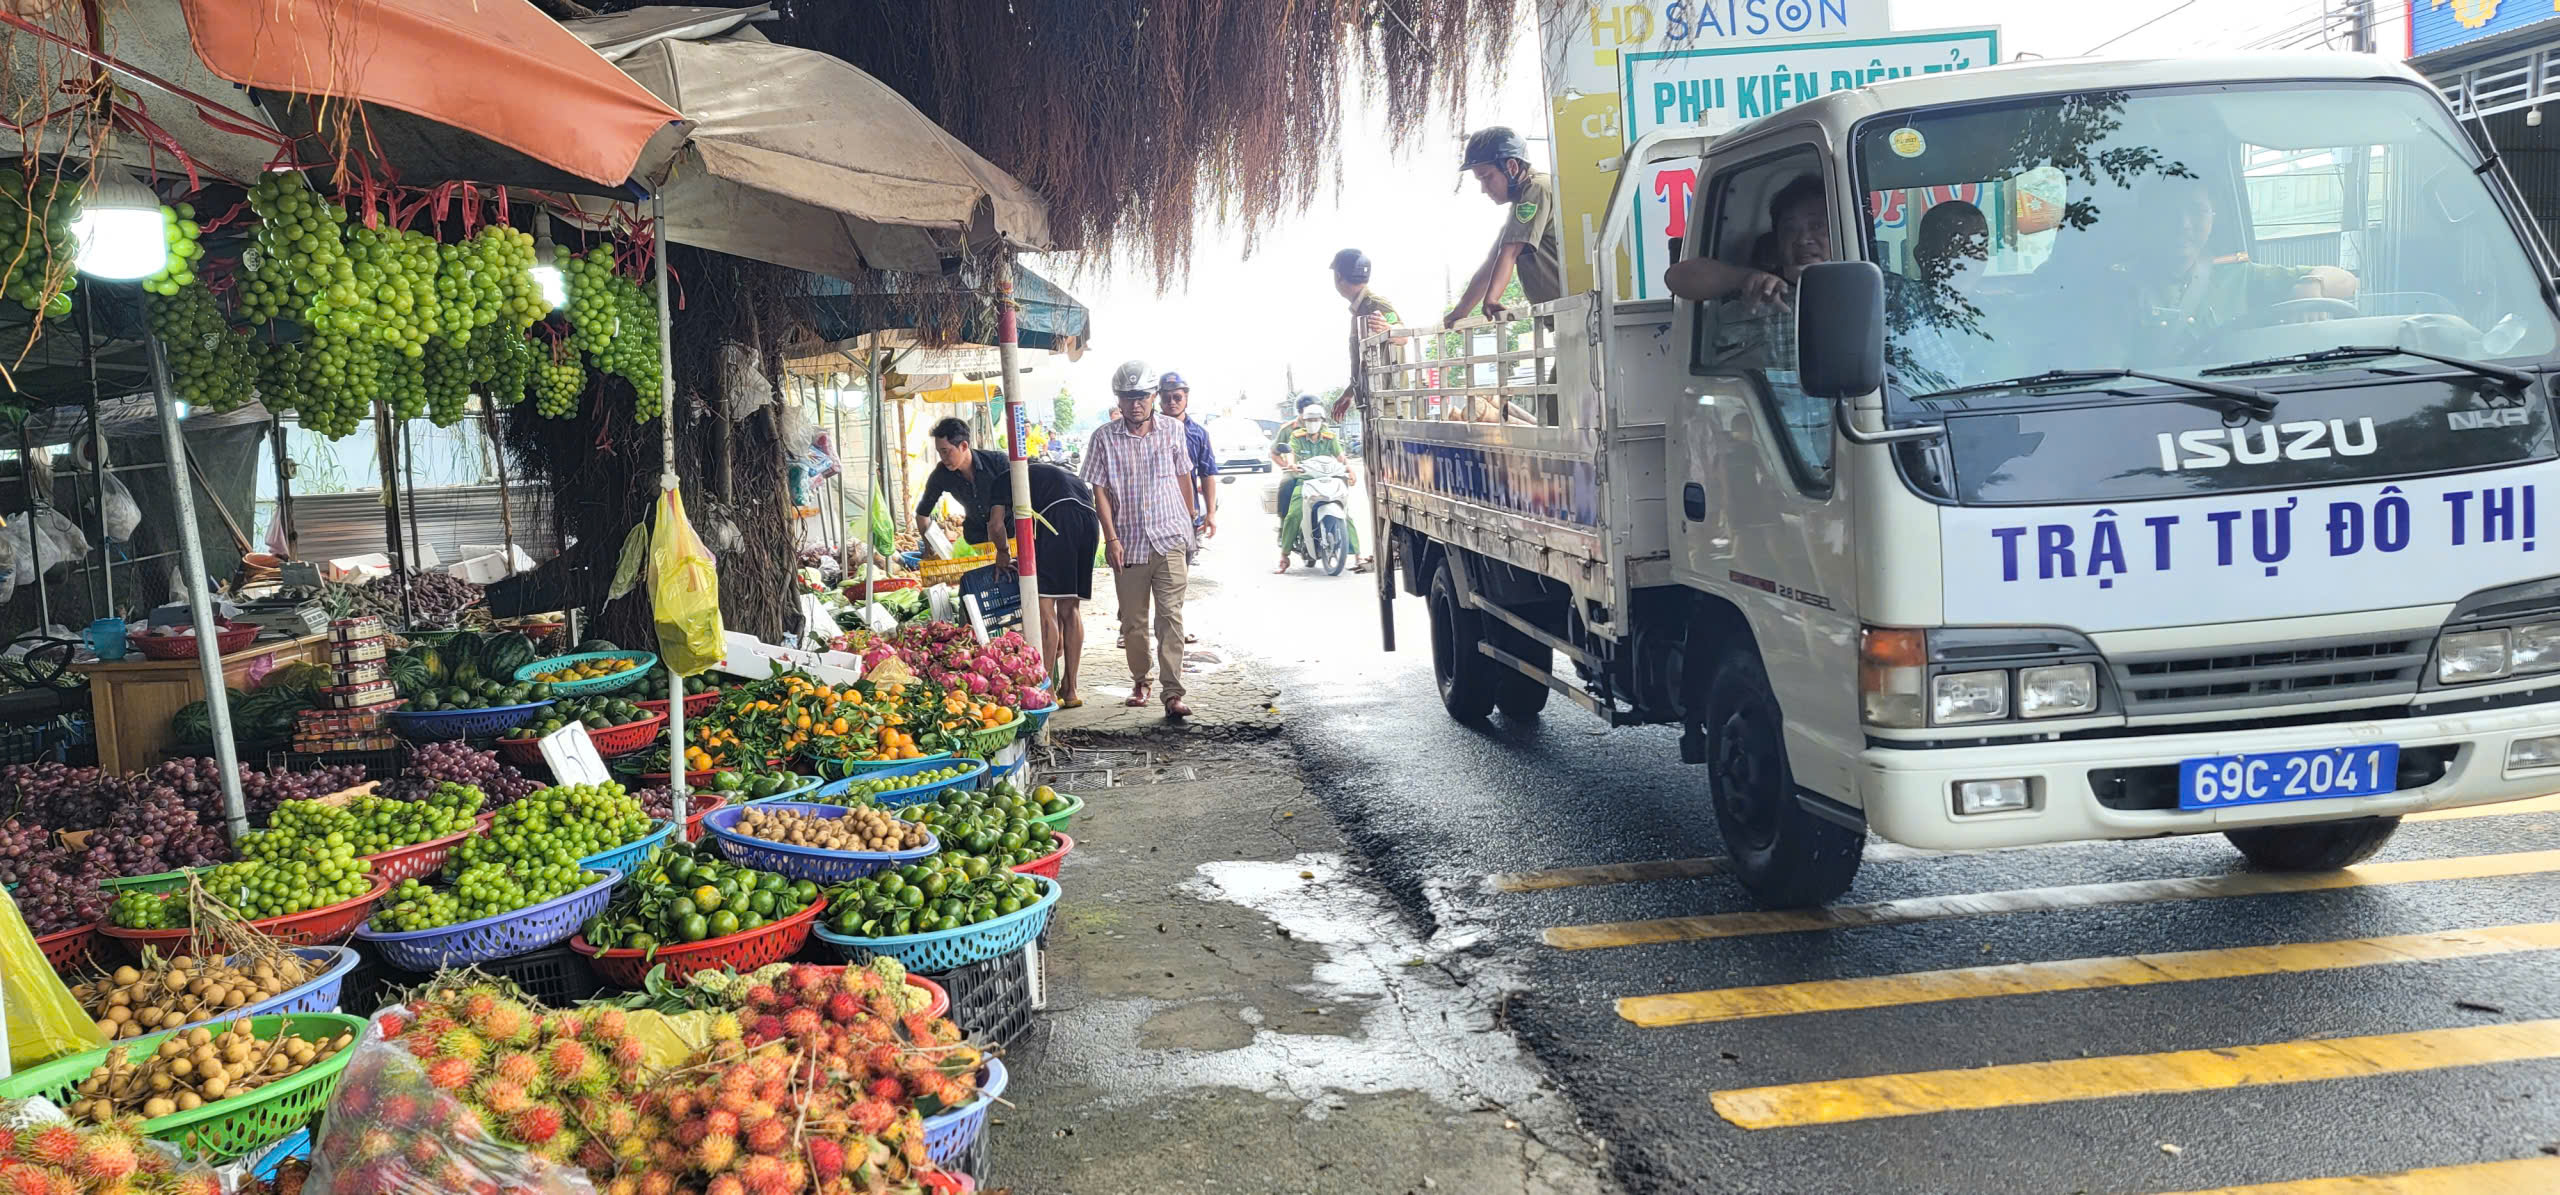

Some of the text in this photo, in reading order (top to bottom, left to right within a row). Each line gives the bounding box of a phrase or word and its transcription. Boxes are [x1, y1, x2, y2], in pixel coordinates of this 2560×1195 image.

[1590, 0, 1847, 46] HD SAISON
[2156, 416, 2378, 472] ISUZU
[2447, 407, 2531, 431] NKR
[1991, 484, 2536, 589] TRẬT TỰ ĐÔ THỊ
[2194, 750, 2380, 803] 69C-2041
